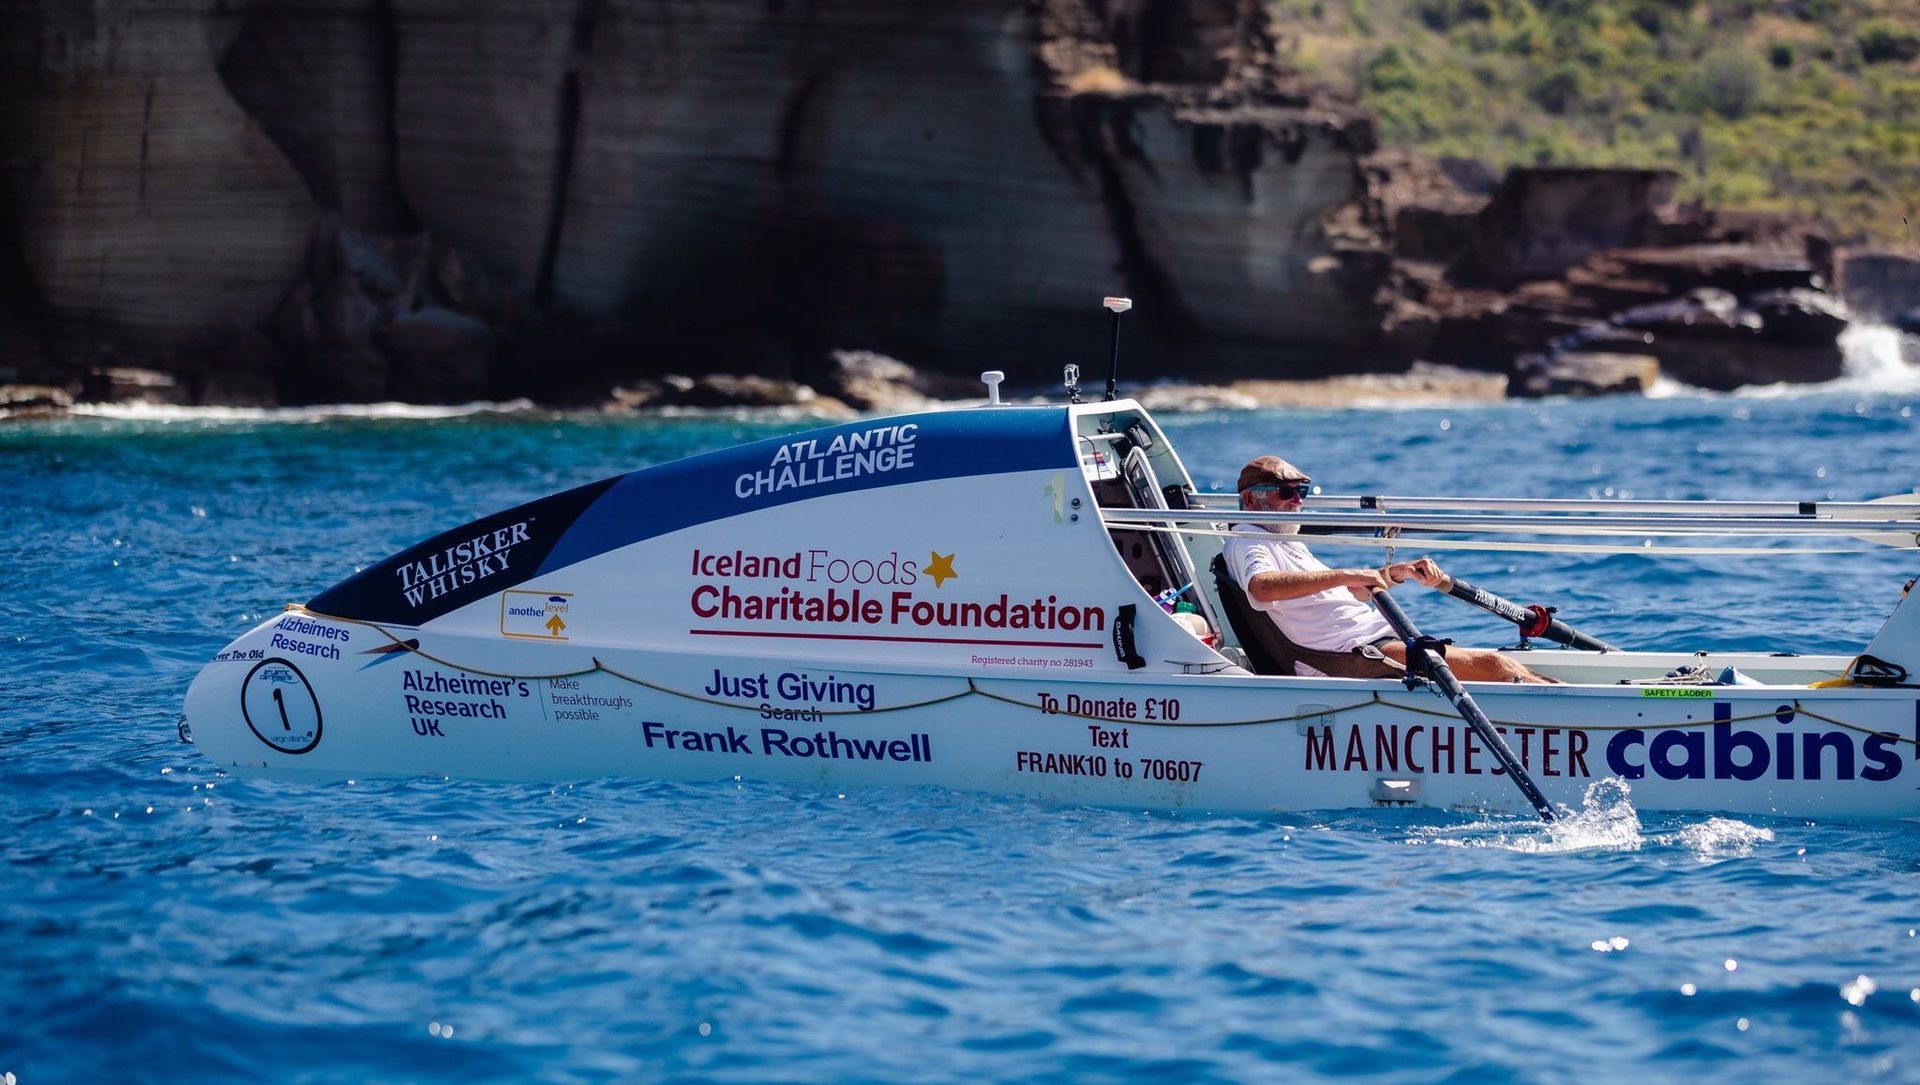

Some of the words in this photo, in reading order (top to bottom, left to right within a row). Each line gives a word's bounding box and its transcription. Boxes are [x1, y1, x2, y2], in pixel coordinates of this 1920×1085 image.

[770, 424, 919, 467] ATLANTIC
[735, 443, 916, 499] CHALLENGE
[397, 522, 531, 591] TALISKER
[691, 549, 801, 579] Iceland
[806, 550, 917, 585] Foods
[403, 549, 512, 609] WHISKY
[508, 606, 545, 617] another
[545, 602, 569, 613] level
[691, 584, 883, 625] Charitable
[890, 591, 1105, 632] Foundation
[274, 617, 350, 642] Alzheimers
[232, 650, 247, 660] Too
[248, 649, 265, 659] Old
[270, 633, 340, 660] Research
[971, 655, 1016, 667] Registered
[1017, 657, 1049, 669] charity
[1049, 660, 1062, 668] no
[1063, 658, 1094, 668] 281943
[403, 670, 530, 698] Alzheimer's
[550, 678, 580, 690] Make
[704, 669, 769, 699] Just
[777, 672, 875, 712] Giving
[1644, 688, 1677, 697] SAFETY
[1678, 689, 1712, 698] LADDER
[272, 688, 292, 731] 1
[404, 694, 507, 720] Research
[552, 694, 633, 710] breakthroughs
[555, 709, 600, 722] possible
[760, 703, 824, 723] Search
[1037, 692, 1059, 715] To
[1067, 694, 1137, 719] Donate
[1144, 698, 1180, 721] £10
[411, 718, 446, 738] UK
[641, 721, 753, 755] Frank
[761, 728, 932, 762] Rothwell
[1088, 725, 1129, 749] Text
[1606, 702, 1903, 782] cabins
[1017, 751, 1107, 777] FRANK10
[1114, 757, 1134, 779] to
[1140, 758, 1202, 782] 70607
